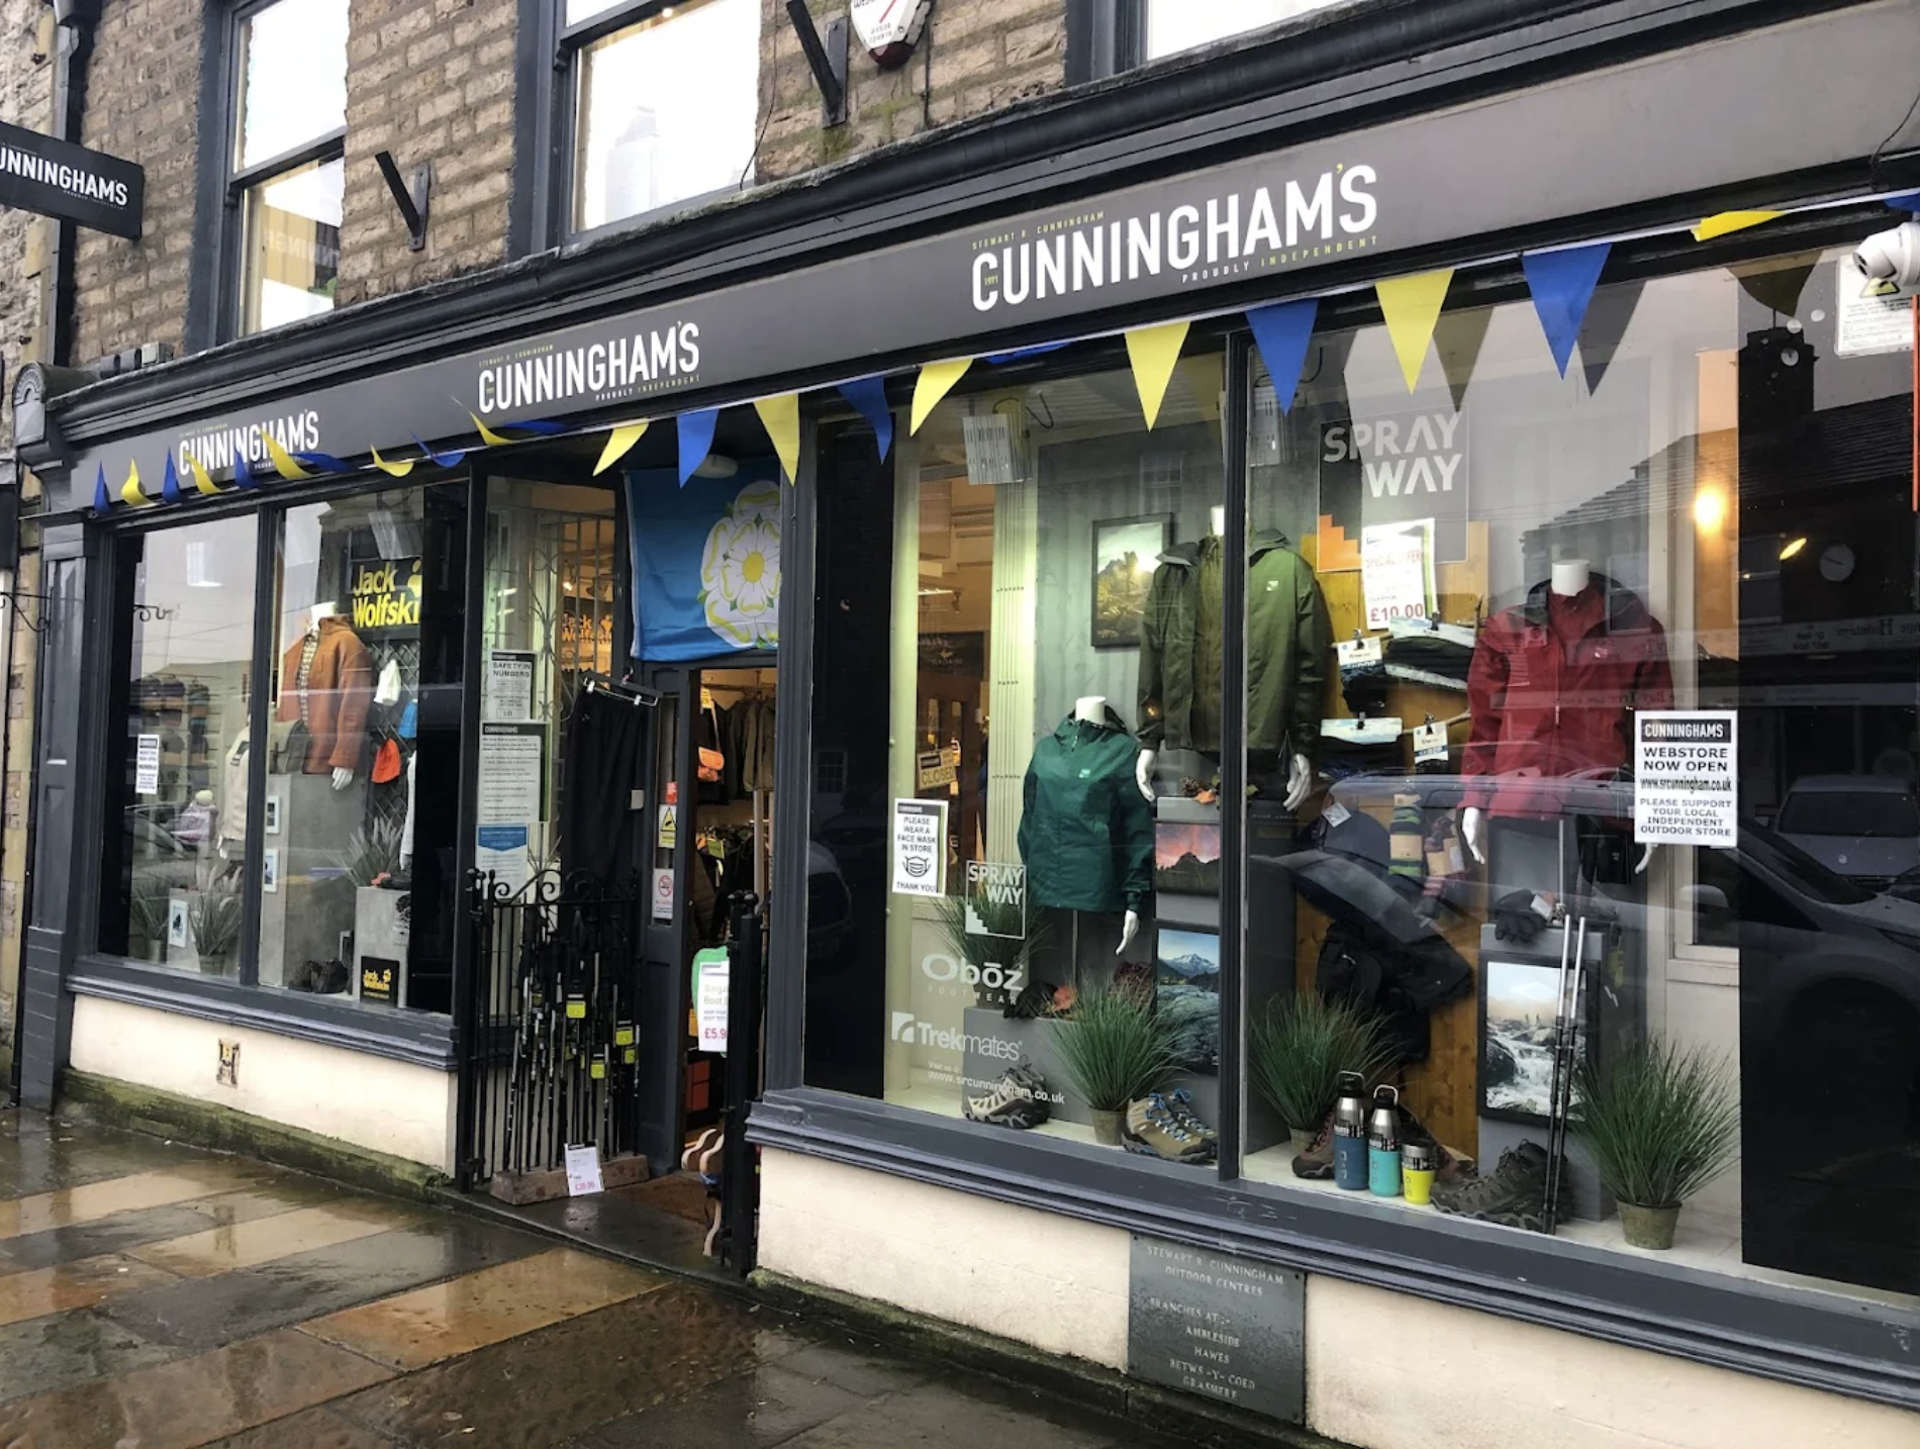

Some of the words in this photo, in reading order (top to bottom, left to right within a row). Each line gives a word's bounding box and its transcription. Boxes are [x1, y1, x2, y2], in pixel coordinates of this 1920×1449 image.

[972, 232, 1015, 250] STEWART
[1037, 211, 1104, 234] CUNNINGHAM
[972, 163, 1377, 311] CUNNINGHAM'S
[1182, 261, 1249, 283] PROUDLY
[1260, 235, 1377, 267] INDEPENDENT
[478, 320, 699, 413] CUNNINGHAM'S
[1323, 411, 1463, 462] SPRAY
[1365, 453, 1463, 498] WAY
[352, 561, 398, 596] Jack
[1370, 603, 1424, 621] £1000
[1643, 747, 1728, 759] WEBSTORE
[921, 766, 954, 785] CLOSED
[1643, 761, 1680, 771] NOW
[1686, 761, 1727, 772] OPEN
[1640, 775, 1732, 794] www.srcunningham.co.uk
[1640, 798, 1678, 807] PLEASE
[1681, 799, 1732, 808] SUPPORT
[1652, 807, 1681, 816] YOUR
[1684, 808, 1719, 818] LOCAL
[903, 816, 930, 825] PLEASE
[903, 825, 924, 834] WEAR
[925, 826, 931, 834] A
[1647, 816, 1724, 827] INDEPENDENT
[897, 834, 916, 842] FACE
[917, 835, 936, 843] MASK
[1640, 825, 1693, 836] OUTDOOR
[1695, 827, 1731, 837] STORE
[910, 845, 932, 853] STORE
[968, 864, 1024, 886] SPRAY
[896, 882, 919, 890] THANK
[921, 884, 936, 892] YOU
[985, 884, 1023, 905] WAY
[1146, 1246, 1193, 1264] STEWART
[1209, 1260, 1284, 1285] CUNNINGHAM
[1165, 1266, 1213, 1285] OUTDOOR
[1216, 1278, 1262, 1297] CENTRES
[1149, 1297, 1201, 1317] BRANCHES
[1185, 1326, 1240, 1347] AMBLESIDE
[1194, 1346, 1230, 1364] HAWES
[1228, 1374, 1255, 1390] COED
